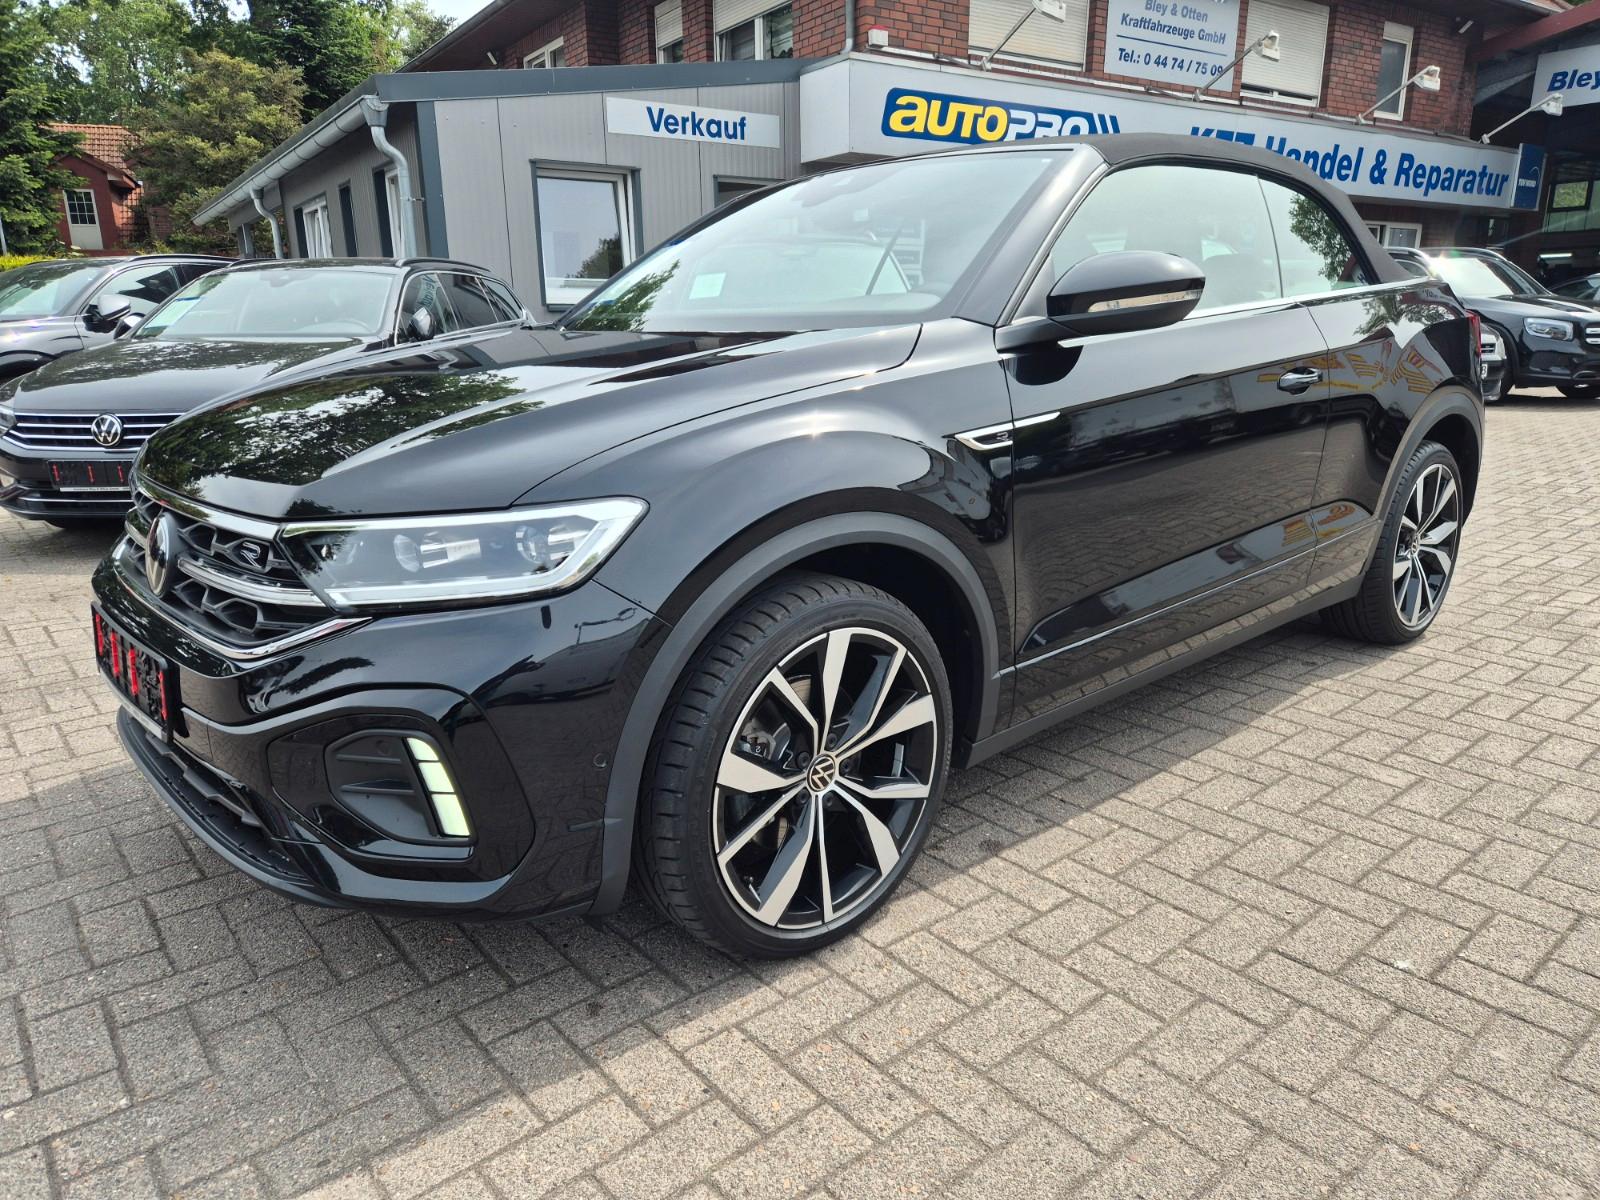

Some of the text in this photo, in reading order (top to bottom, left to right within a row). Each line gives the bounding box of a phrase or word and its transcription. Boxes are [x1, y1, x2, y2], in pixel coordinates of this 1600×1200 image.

[1145, 0, 1208, 23] Bley & Otten
[1121, 13, 1227, 45] Kraftfahrzeuge GmbH
[1118, 48, 1224, 77] Tel.: 0 44 74 / 75 09
[646, 105, 747, 141] Verkauf
[1369, 149, 1388, 185] &
[1394, 152, 1510, 197] Reparatur
